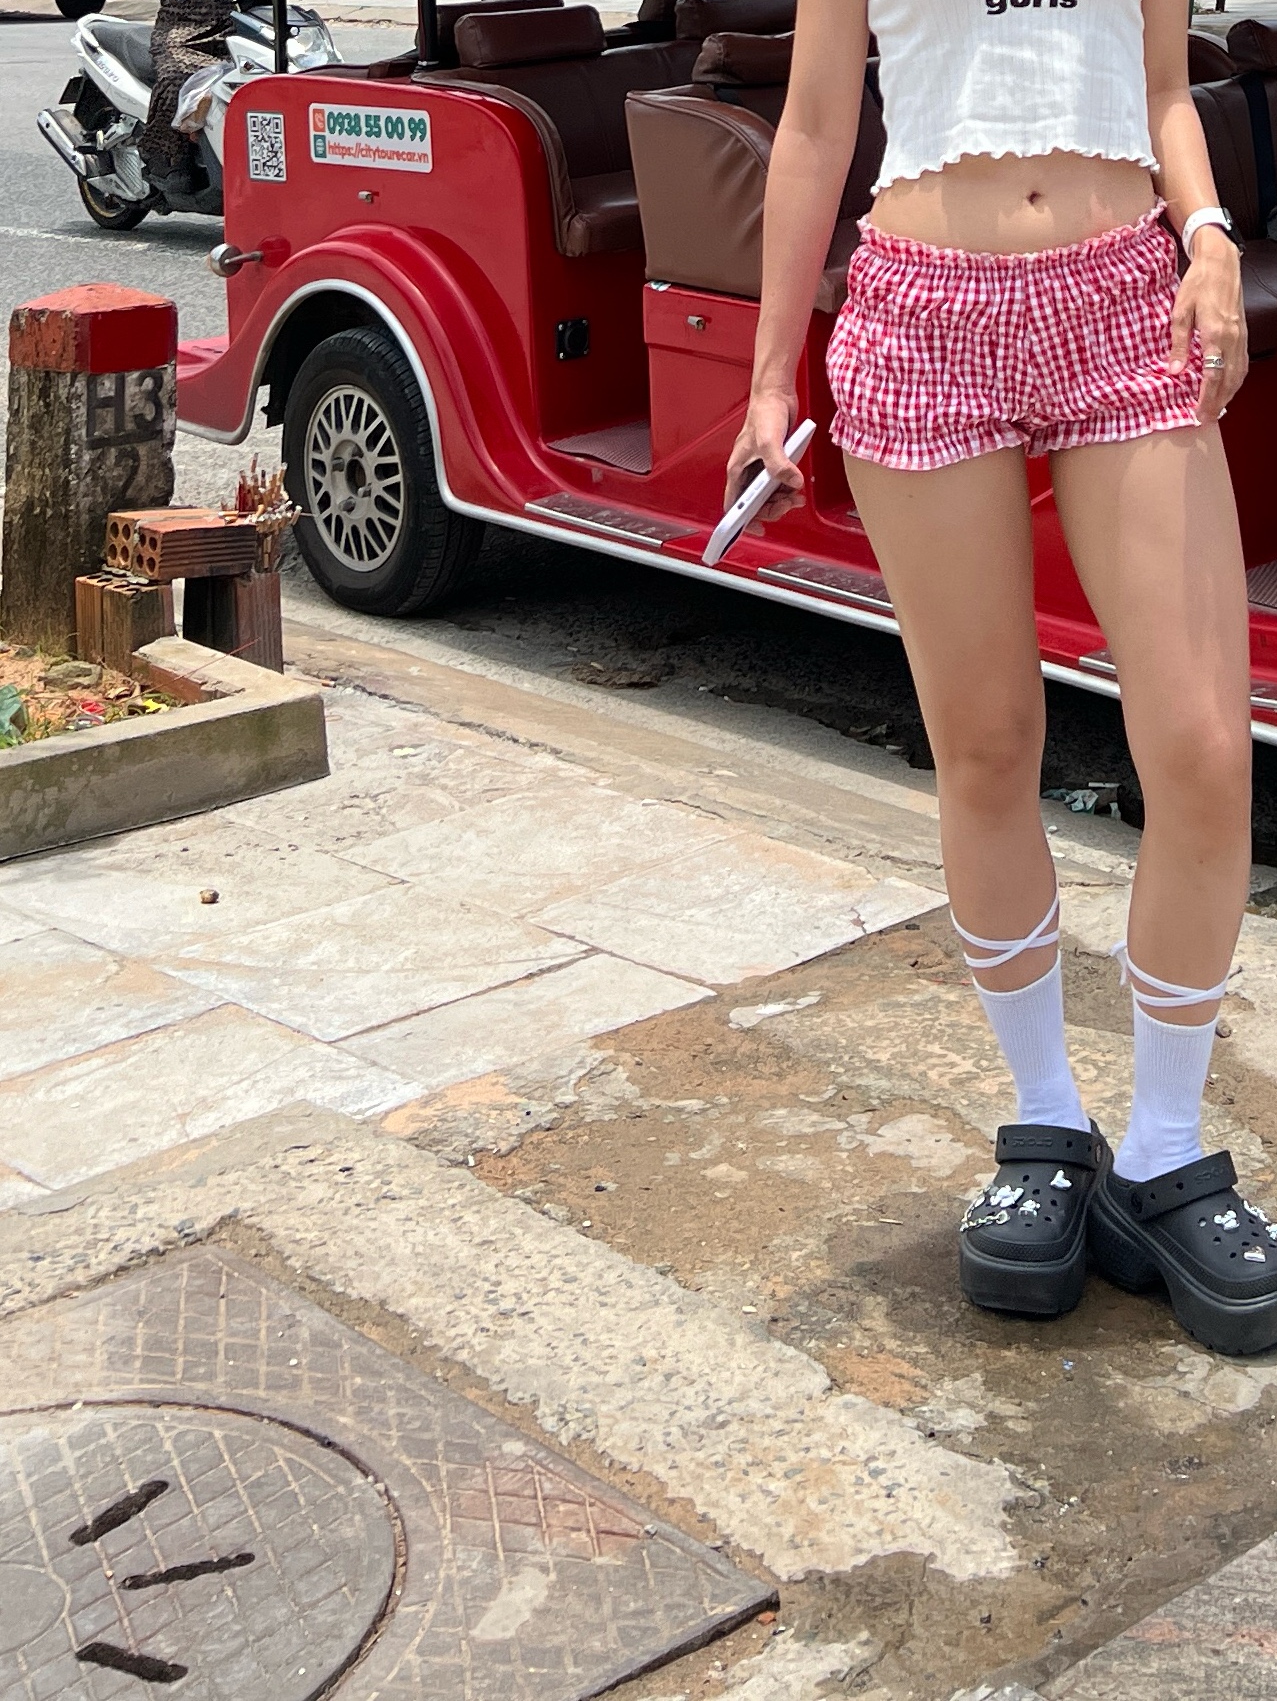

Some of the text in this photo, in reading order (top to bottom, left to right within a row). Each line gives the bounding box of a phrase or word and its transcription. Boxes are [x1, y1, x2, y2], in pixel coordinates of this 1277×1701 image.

[327, 111, 427, 142] 0938 55 00 99
[86, 369, 164, 437] H3
